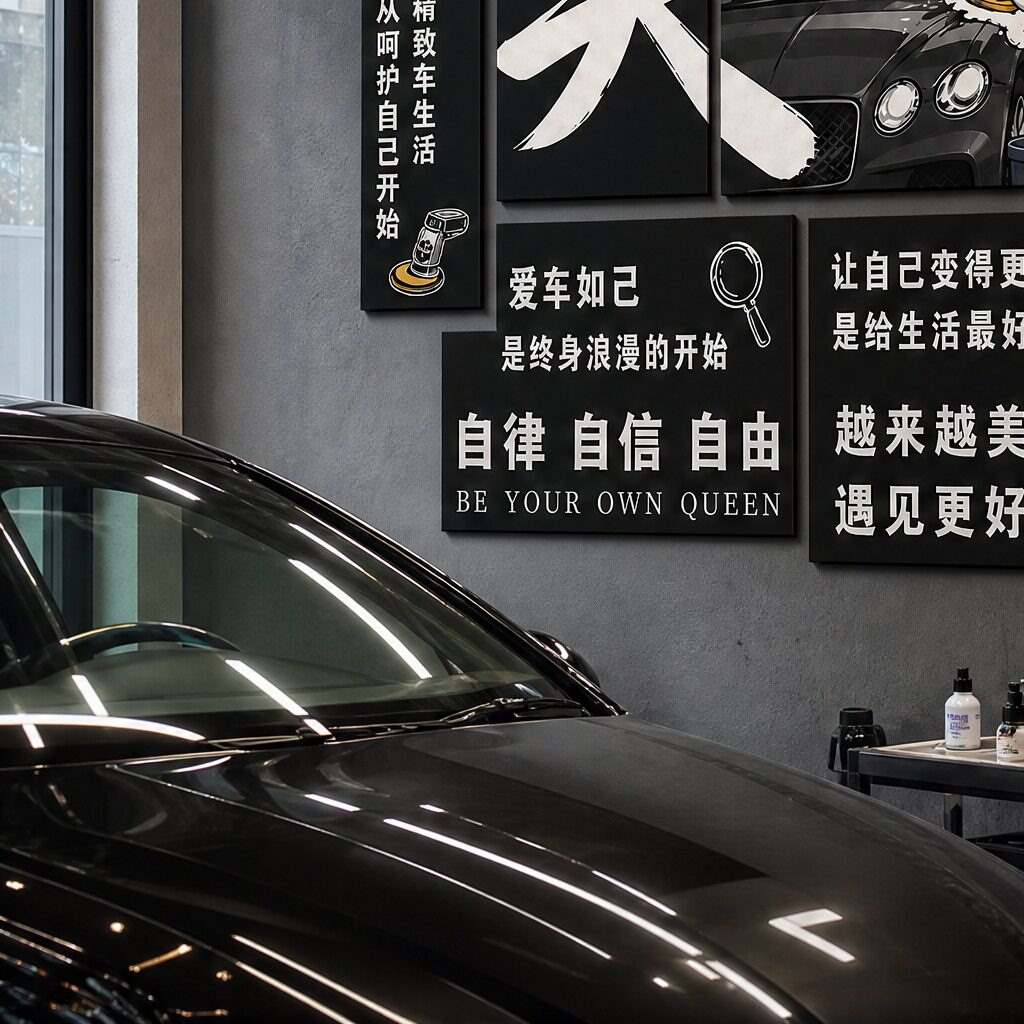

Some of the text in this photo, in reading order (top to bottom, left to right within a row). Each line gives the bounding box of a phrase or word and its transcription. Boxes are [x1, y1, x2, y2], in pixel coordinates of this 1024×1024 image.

[508, 265, 640, 311] 爱车如己
[500, 333, 729, 373] 是终身浪漫的开始
[458, 410, 780, 472] 自律 自信 自由
[456, 490, 781, 521] BE YOUR OWN QUEEN
